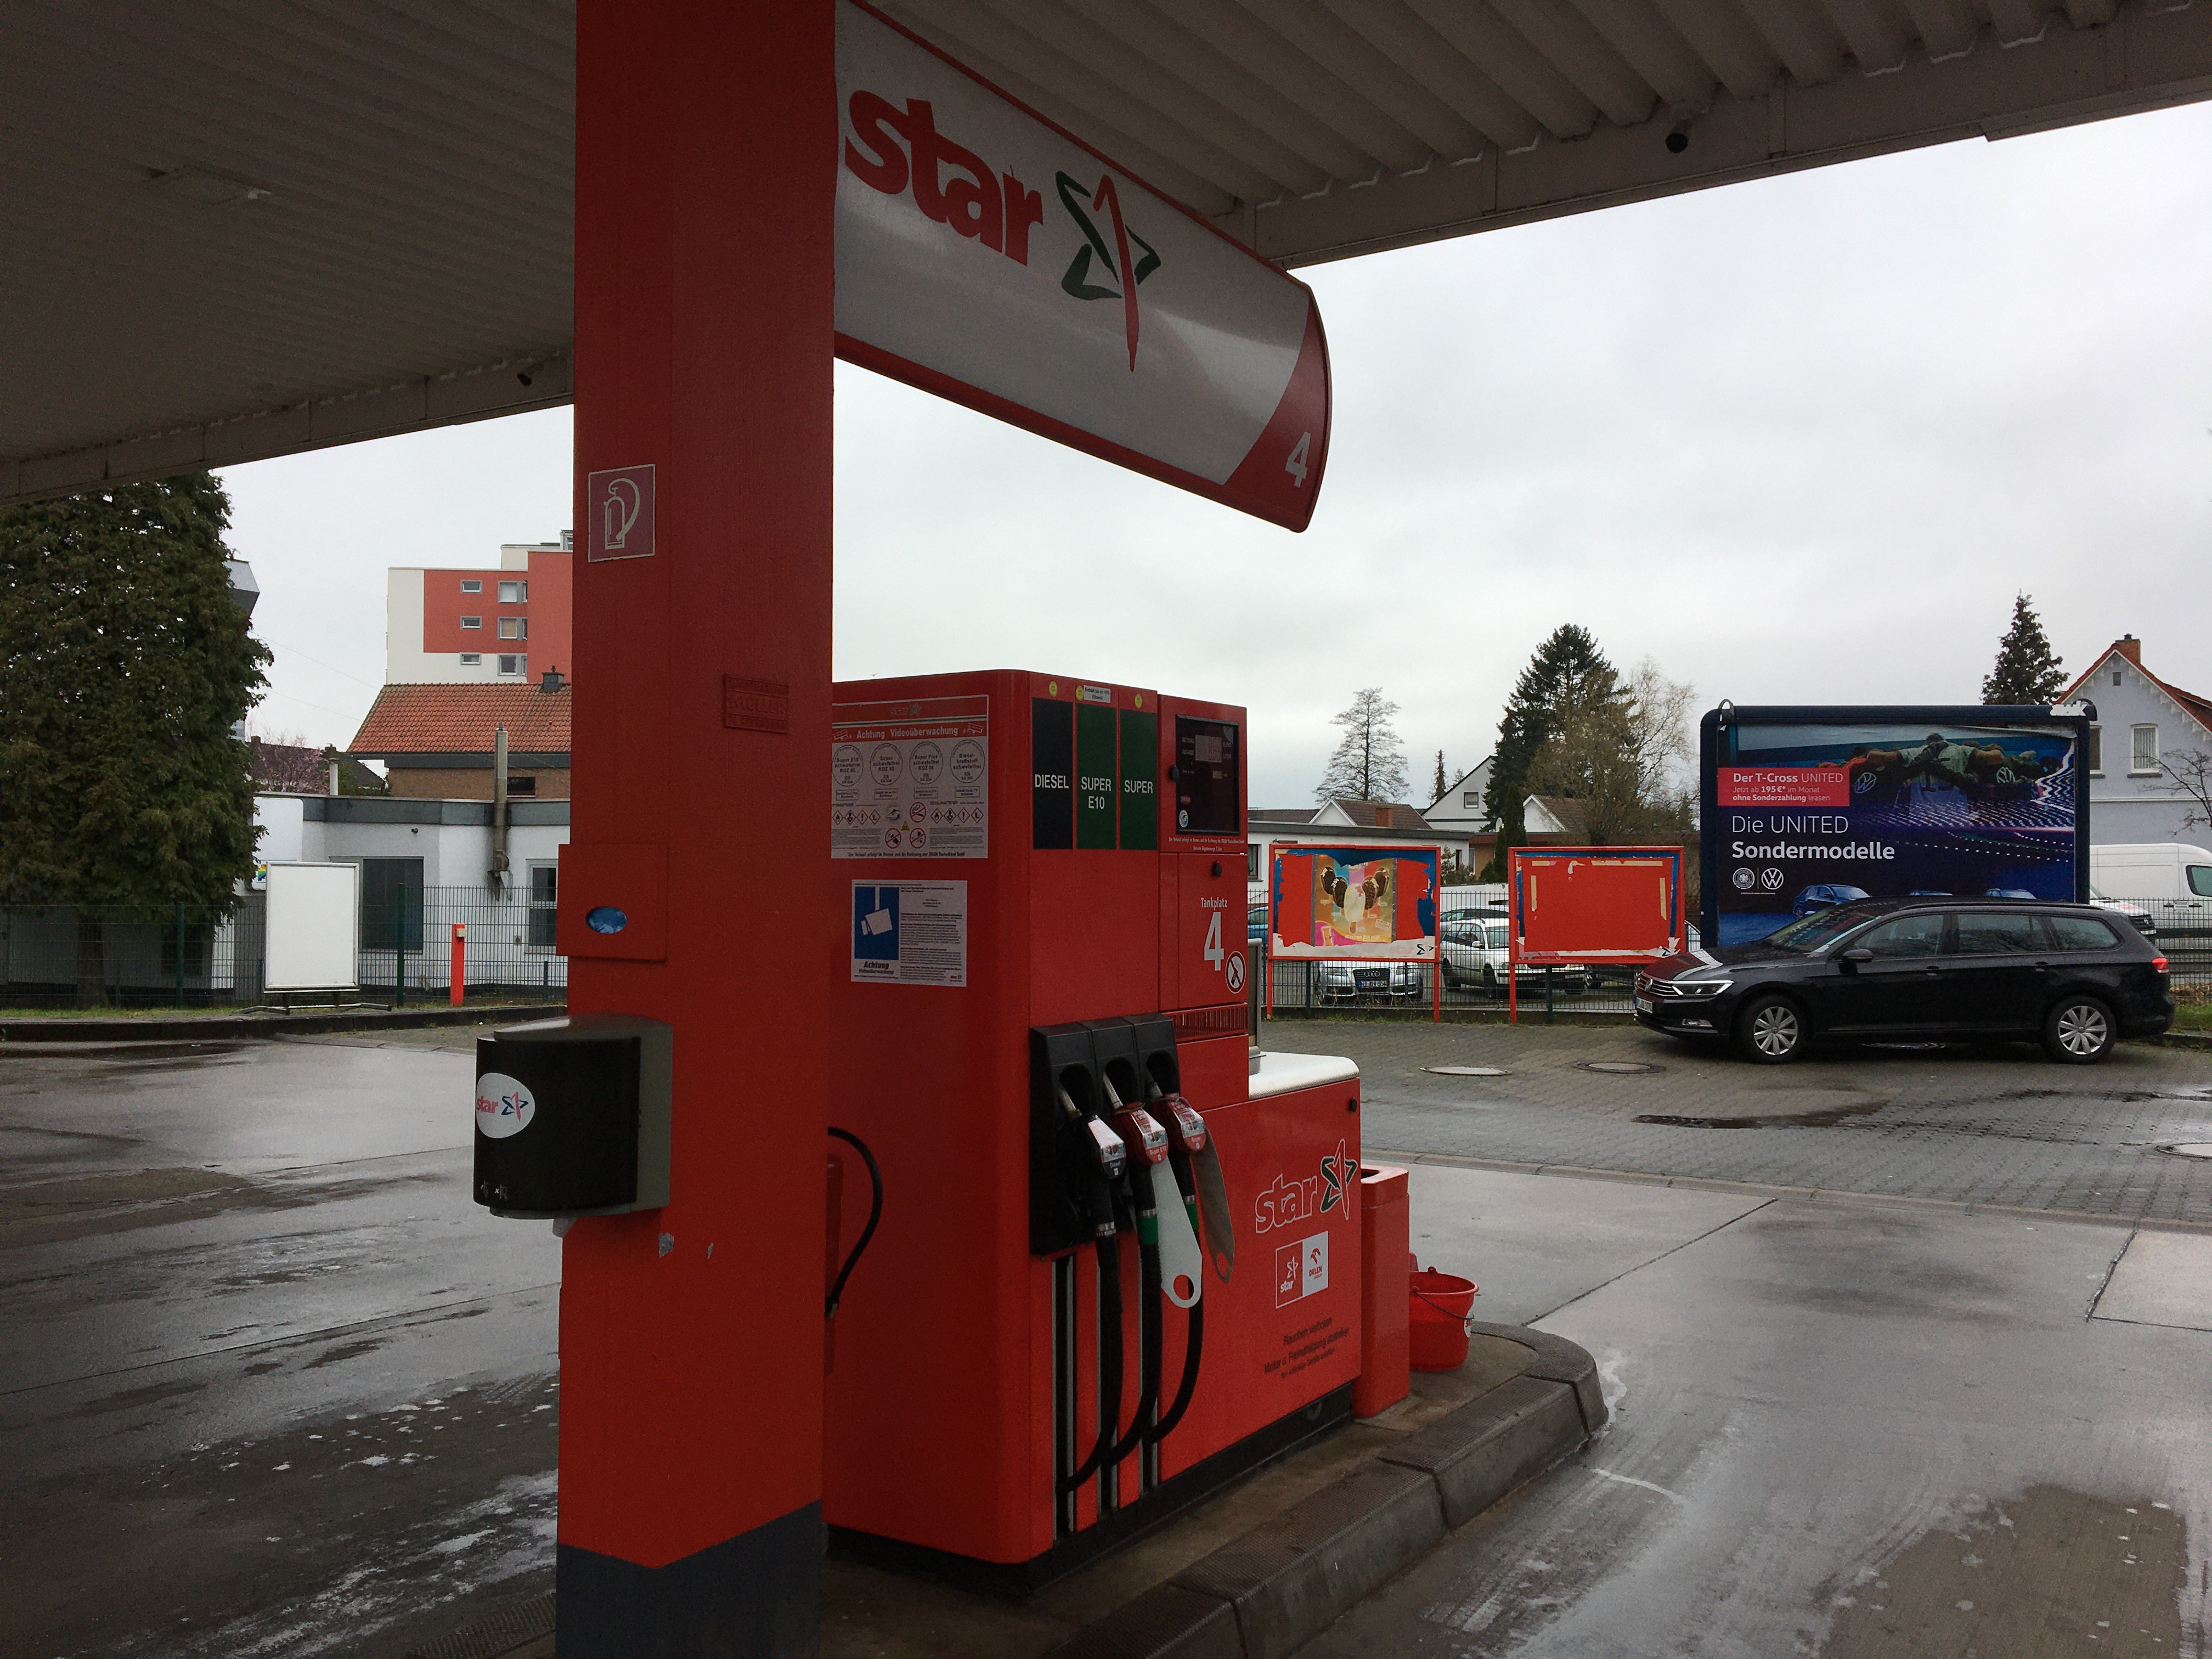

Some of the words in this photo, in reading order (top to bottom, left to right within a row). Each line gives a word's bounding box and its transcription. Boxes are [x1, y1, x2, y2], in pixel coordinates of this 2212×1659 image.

[845, 89, 1043, 267] star
[1285, 431, 1312, 488] 4
[856, 730, 885, 740] Achtung
[890, 727, 958, 737] Videoüberwachung
[1035, 774, 1069, 789] DIESEL
[1081, 776, 1111, 792] SUPER
[1734, 773, 1753, 782] Der
[1756, 773, 1798, 782] T-Cross
[1802, 773, 1843, 783] UNITED
[1124, 780, 1153, 794] SUPER
[1088, 795, 1105, 809] E10
[1732, 816, 1763, 833] Die
[1771, 816, 1849, 833] UNITED
[1732, 841, 1895, 860] Sondermodelle
[1200, 896, 1228, 910] Tankplatz
[1204, 911, 1224, 971] 4
[864, 961, 889, 969] Achtung
[476, 1095, 498, 1114] star
[1255, 1173, 1318, 1233] star
[1309, 1266, 1322, 1277] ORLEN
[1280, 1279, 1294, 1293] star
